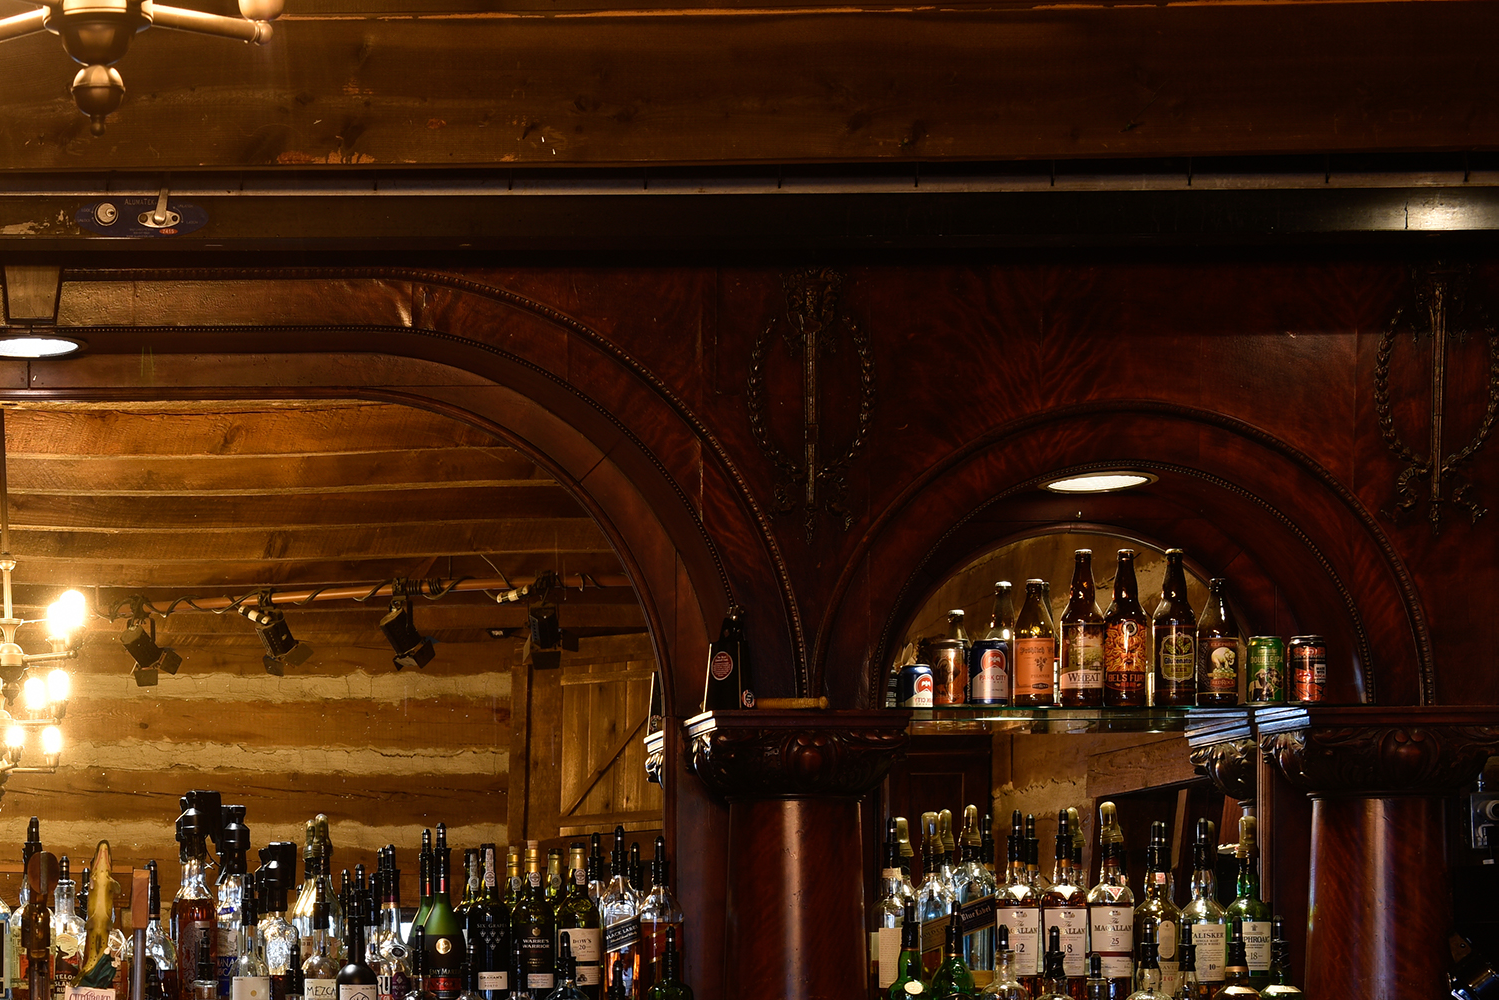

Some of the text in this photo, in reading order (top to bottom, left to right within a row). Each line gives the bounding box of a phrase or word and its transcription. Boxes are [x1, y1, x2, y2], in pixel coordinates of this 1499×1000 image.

[1068, 673, 1101, 682] WHEAT
[961, 906, 991, 921] Blue Label
[1015, 943, 1025, 952] 12
[1063, 944, 1073, 953] 18
[1250, 952, 1257, 960] 18
[307, 986, 336, 996] MEZCA
